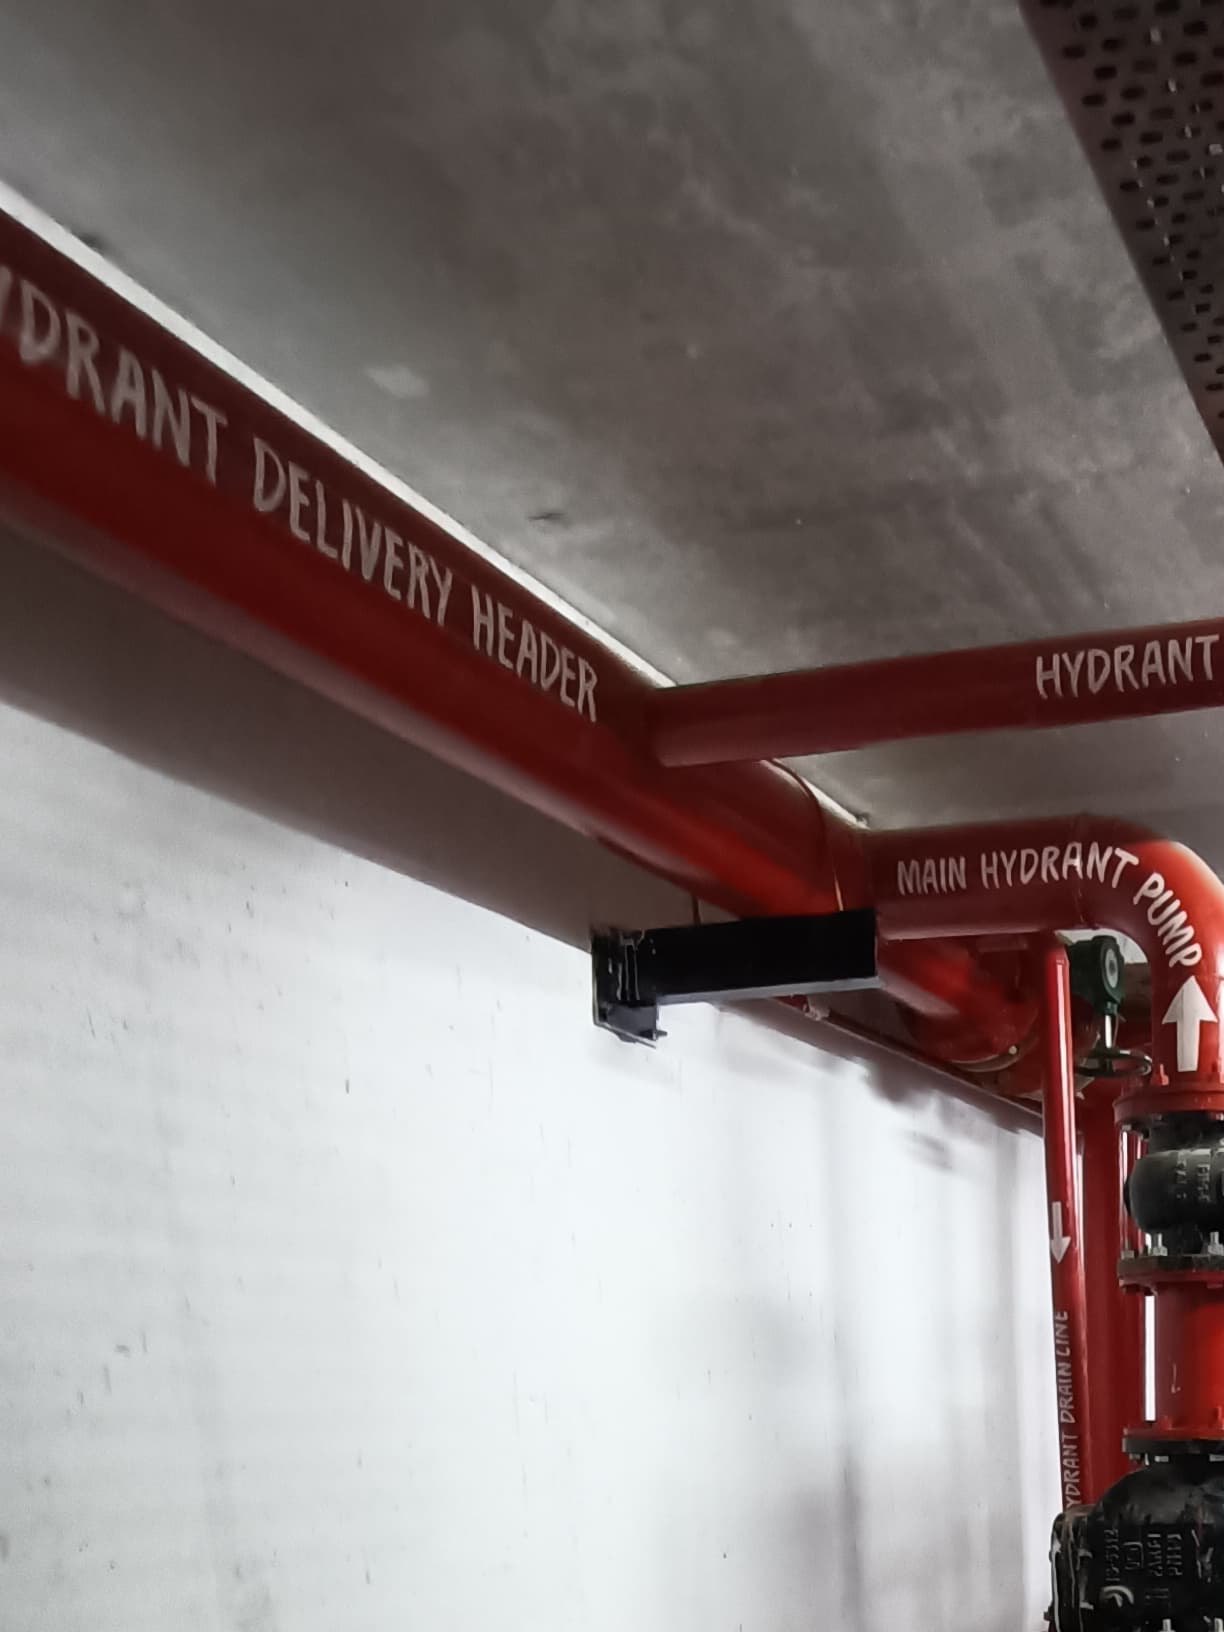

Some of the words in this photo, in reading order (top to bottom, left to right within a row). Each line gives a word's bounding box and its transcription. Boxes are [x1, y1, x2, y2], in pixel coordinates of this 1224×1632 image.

[253, 437, 454, 626] DELIVERY
[471, 585, 598, 723] HEADER
[1034, 633, 1221, 700] HYDRANT
[897, 855, 967, 895] MAIN
[980, 842, 1140, 890] HYDRANT
[1133, 872, 1204, 969] PUMP
[1055, 1310, 1071, 1356] LINE
[1057, 1362, 1076, 1424] DRAIN
[1061, 1433, 1081, 1510] YDRANT
